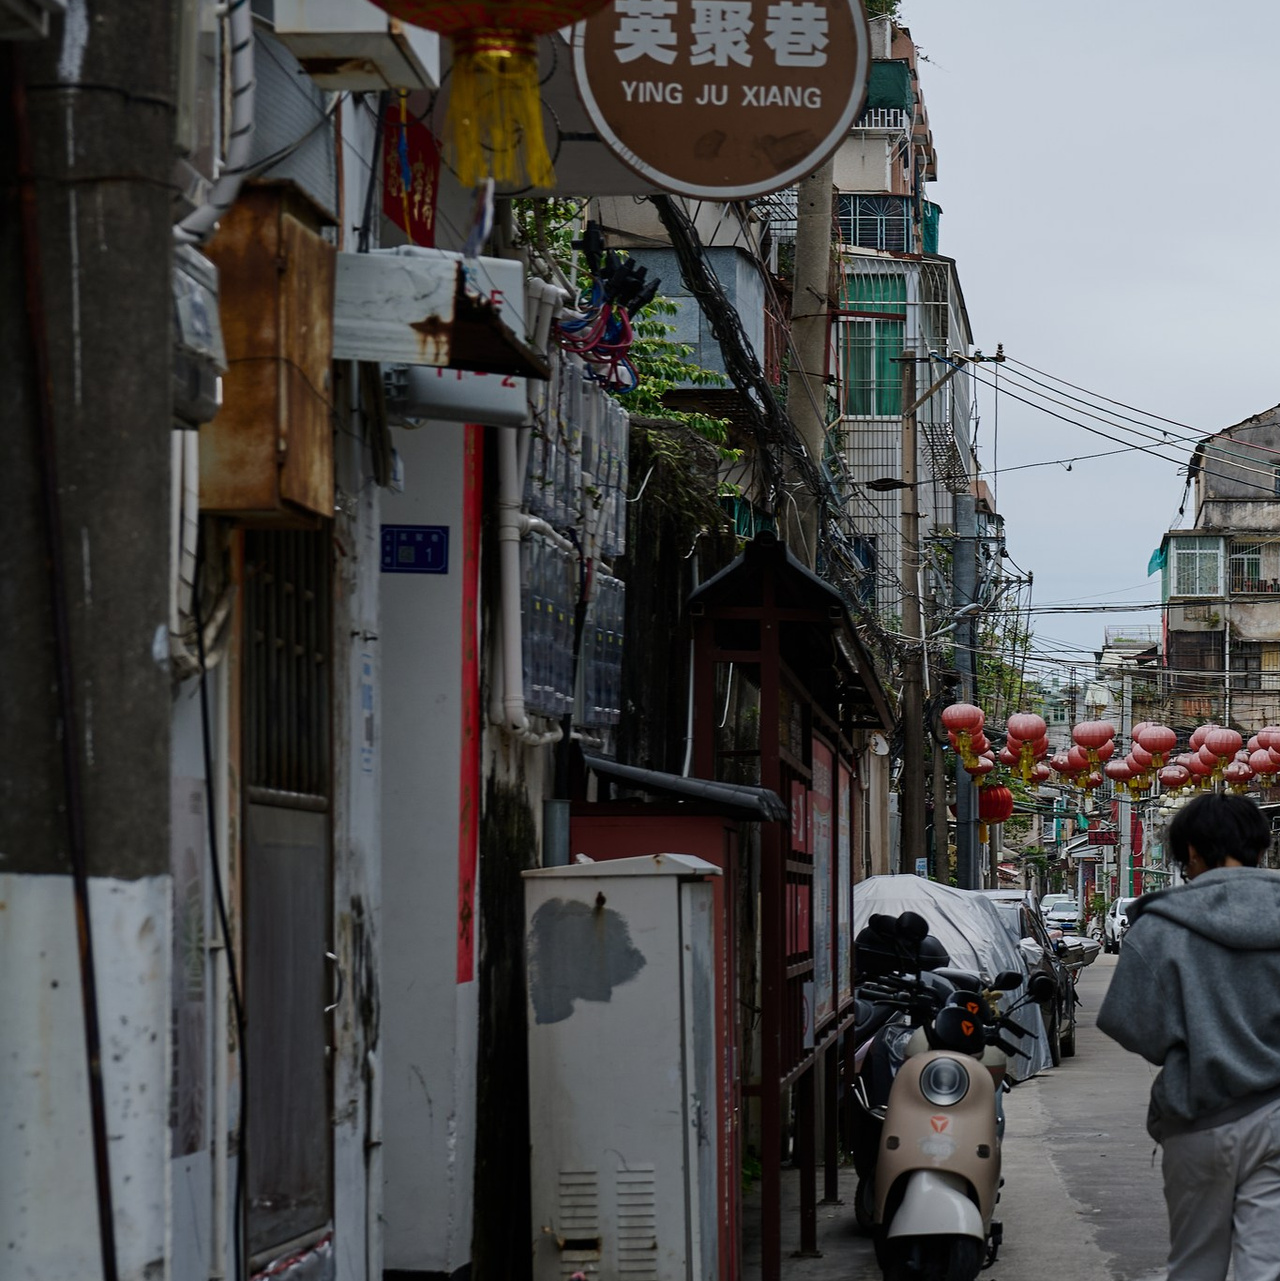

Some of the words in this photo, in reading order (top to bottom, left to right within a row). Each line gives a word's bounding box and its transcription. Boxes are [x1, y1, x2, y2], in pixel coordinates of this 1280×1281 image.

[621, 80, 683, 104] YING
[695, 84, 728, 106] JU
[741, 85, 822, 109] XIANG
